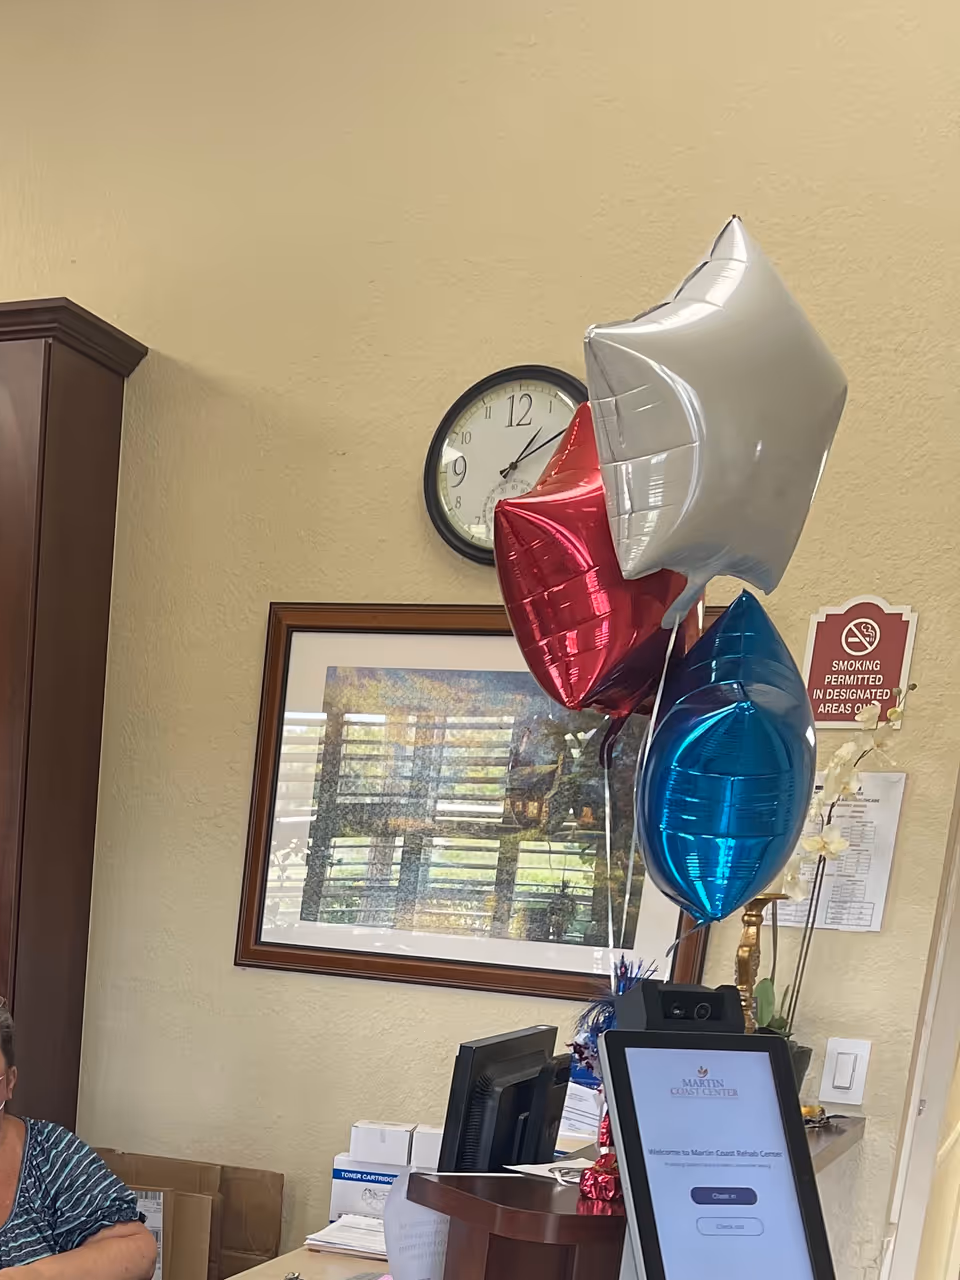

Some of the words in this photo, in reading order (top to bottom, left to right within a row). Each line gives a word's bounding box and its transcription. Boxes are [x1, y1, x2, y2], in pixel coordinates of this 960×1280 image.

[484, 405, 493, 420] 11
[505, 393, 533, 428] 12
[548, 400, 553, 414] 1
[461, 431, 472, 445] 10
[450, 455, 467, 488] 9
[455, 496, 462, 509] 8
[832, 660, 880, 671] SMOKING
[824, 674, 883, 685] PERMITTED
[813, 689, 824, 699] IN
[826, 689, 890, 699] DESIGNATED
[817, 703, 852, 713] AREAS
[682, 1079, 724, 1088] MARTIN
[670, 1087, 699, 1096] COAST
[702, 1088, 738, 1097] CENTER
[760, 1150, 783, 1158] Center
[341, 1172, 361, 1180] TONER
